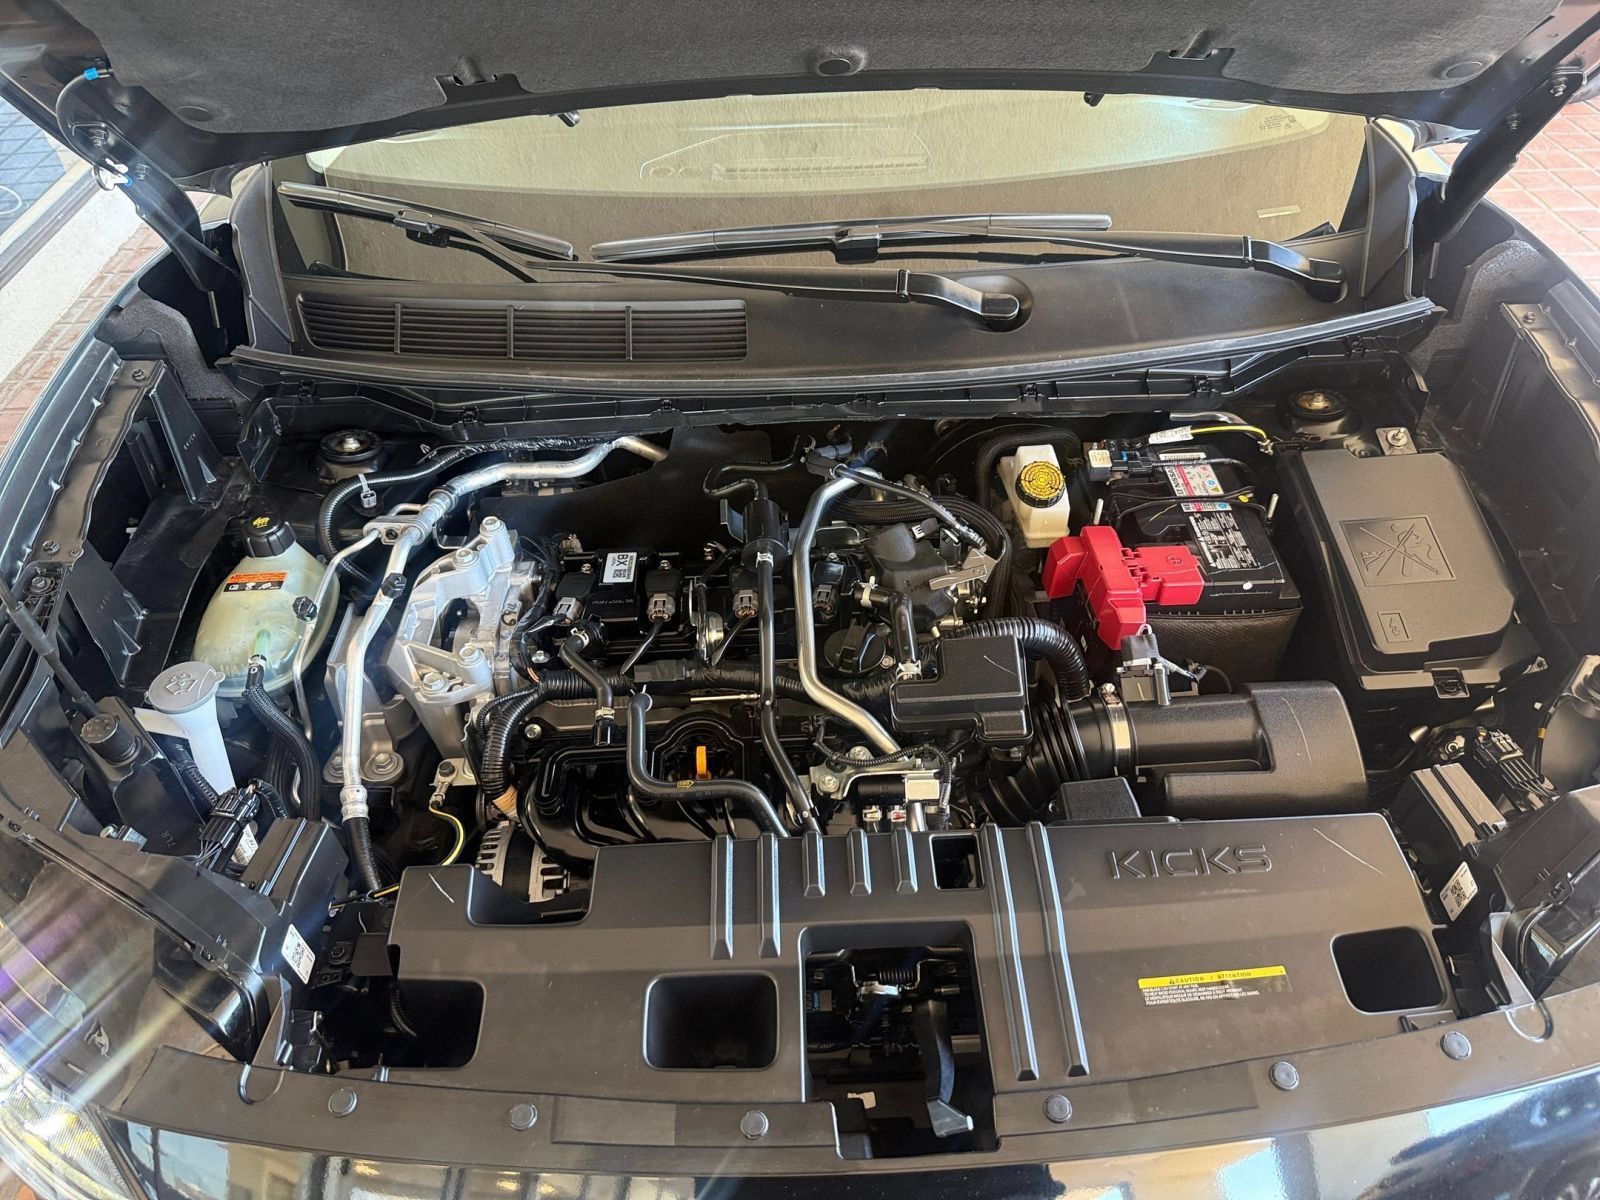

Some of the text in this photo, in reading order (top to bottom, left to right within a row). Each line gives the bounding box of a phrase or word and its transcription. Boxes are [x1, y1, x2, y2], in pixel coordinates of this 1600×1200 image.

[616, 554, 629, 566] BX
[1110, 844, 1273, 879] KICKS
[1175, 976, 1204, 984] CAUTION
[1218, 972, 1252, 980] ATTENTION
